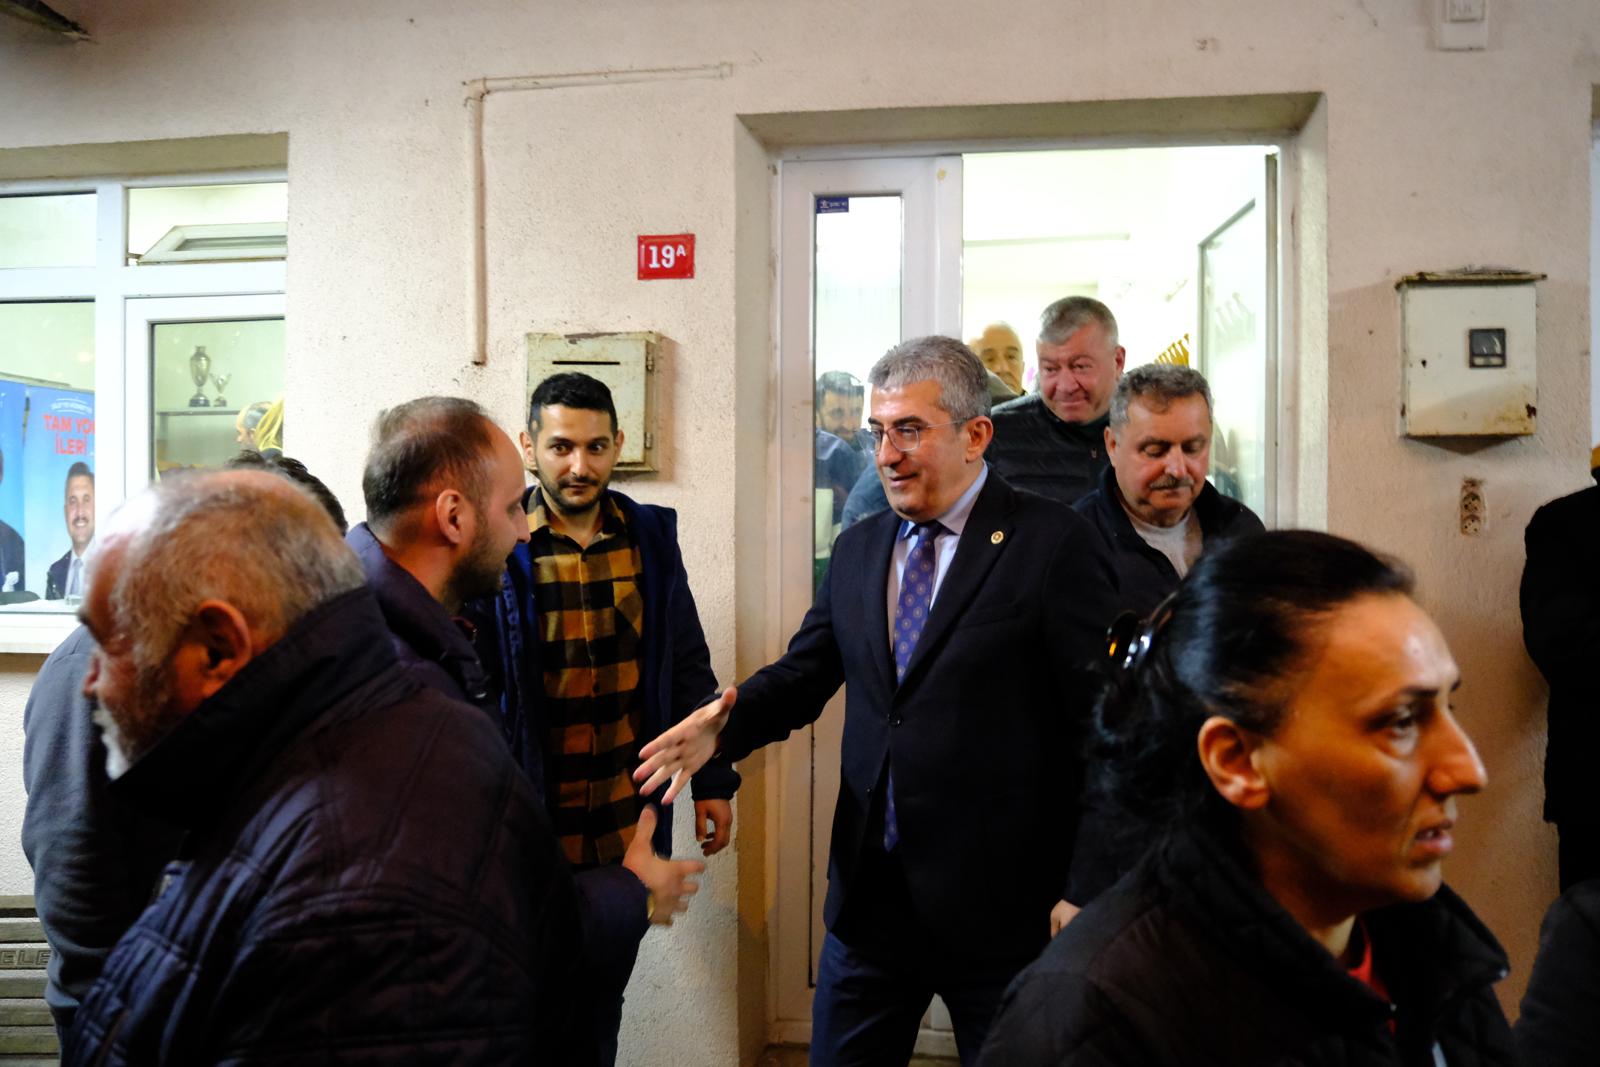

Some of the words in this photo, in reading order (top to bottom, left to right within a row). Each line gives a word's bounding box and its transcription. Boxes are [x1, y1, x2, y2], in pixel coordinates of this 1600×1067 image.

[648, 244, 686, 269] 19A
[43, 414, 73, 433] TAM
[55, 432, 87, 456] İLERİ
